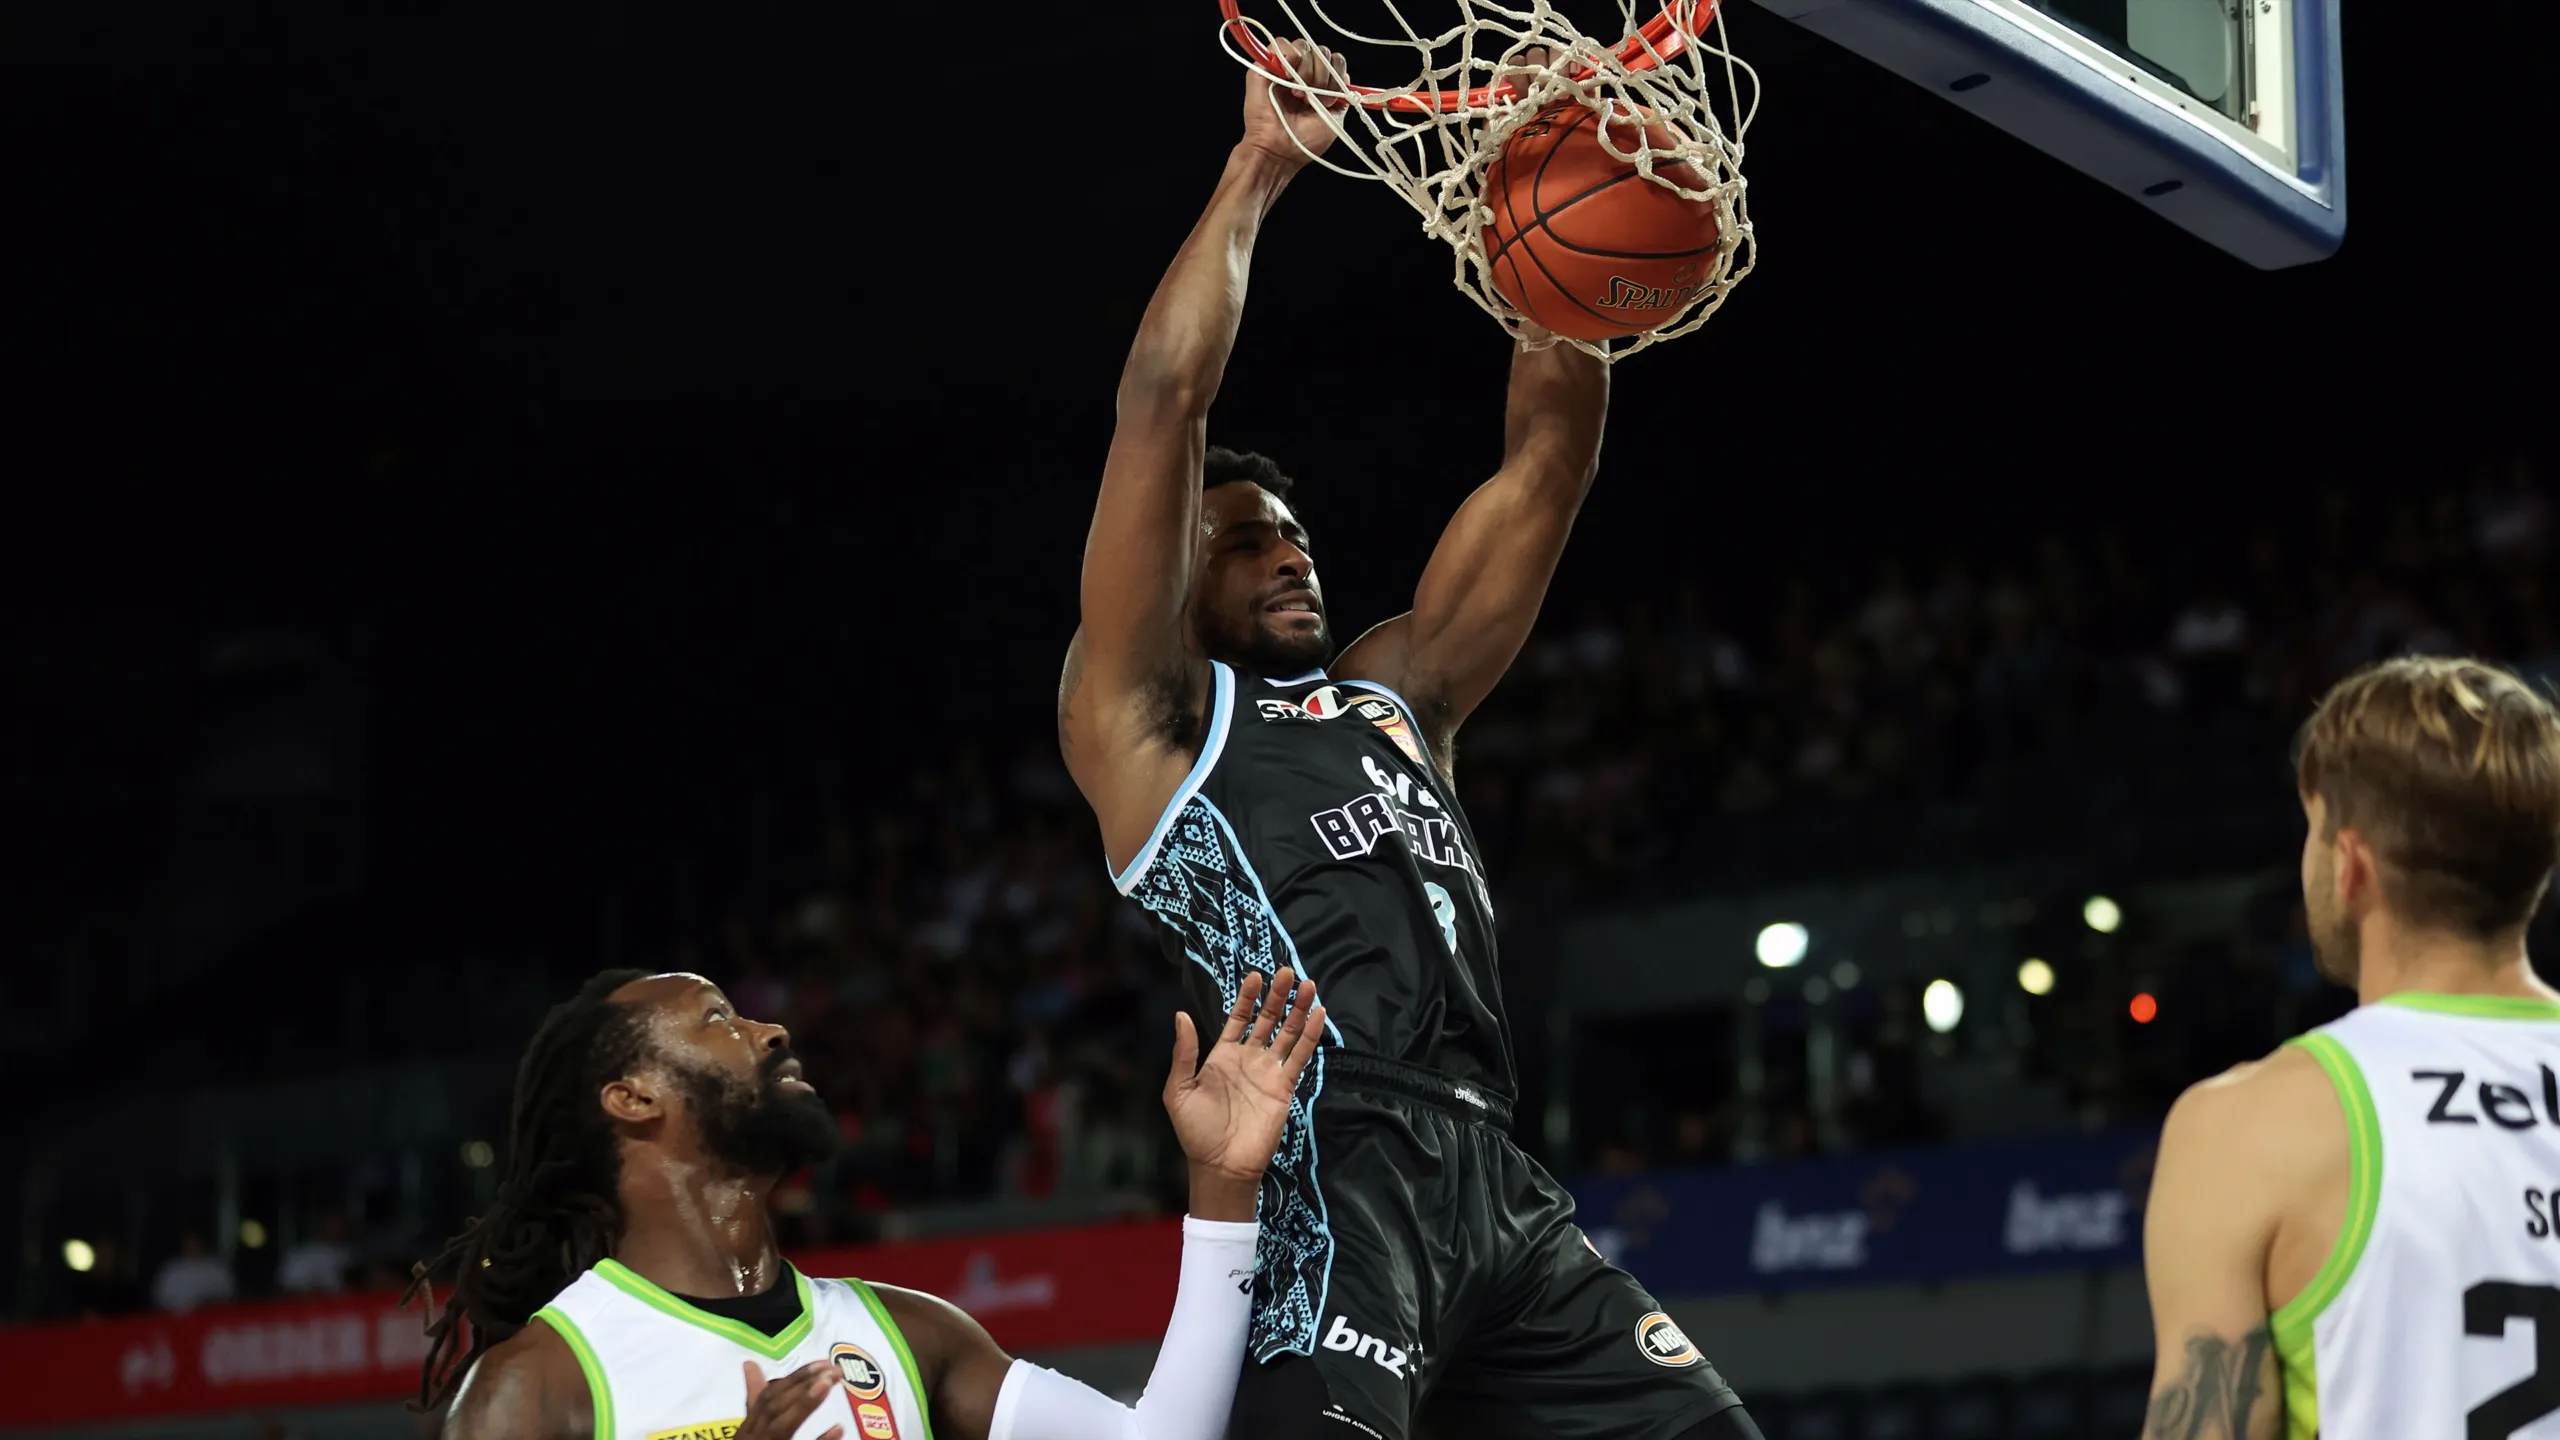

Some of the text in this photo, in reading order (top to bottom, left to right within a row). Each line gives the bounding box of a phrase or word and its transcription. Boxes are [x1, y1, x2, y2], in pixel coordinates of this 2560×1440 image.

[1596, 275, 1704, 311] SPALD
[1321, 1315, 1408, 1381] bnz
[1648, 1326, 1688, 1355] NBL
[838, 1357, 876, 1384] NBL
[1322, 1409, 1383, 1440] UNDER ARMOUR
